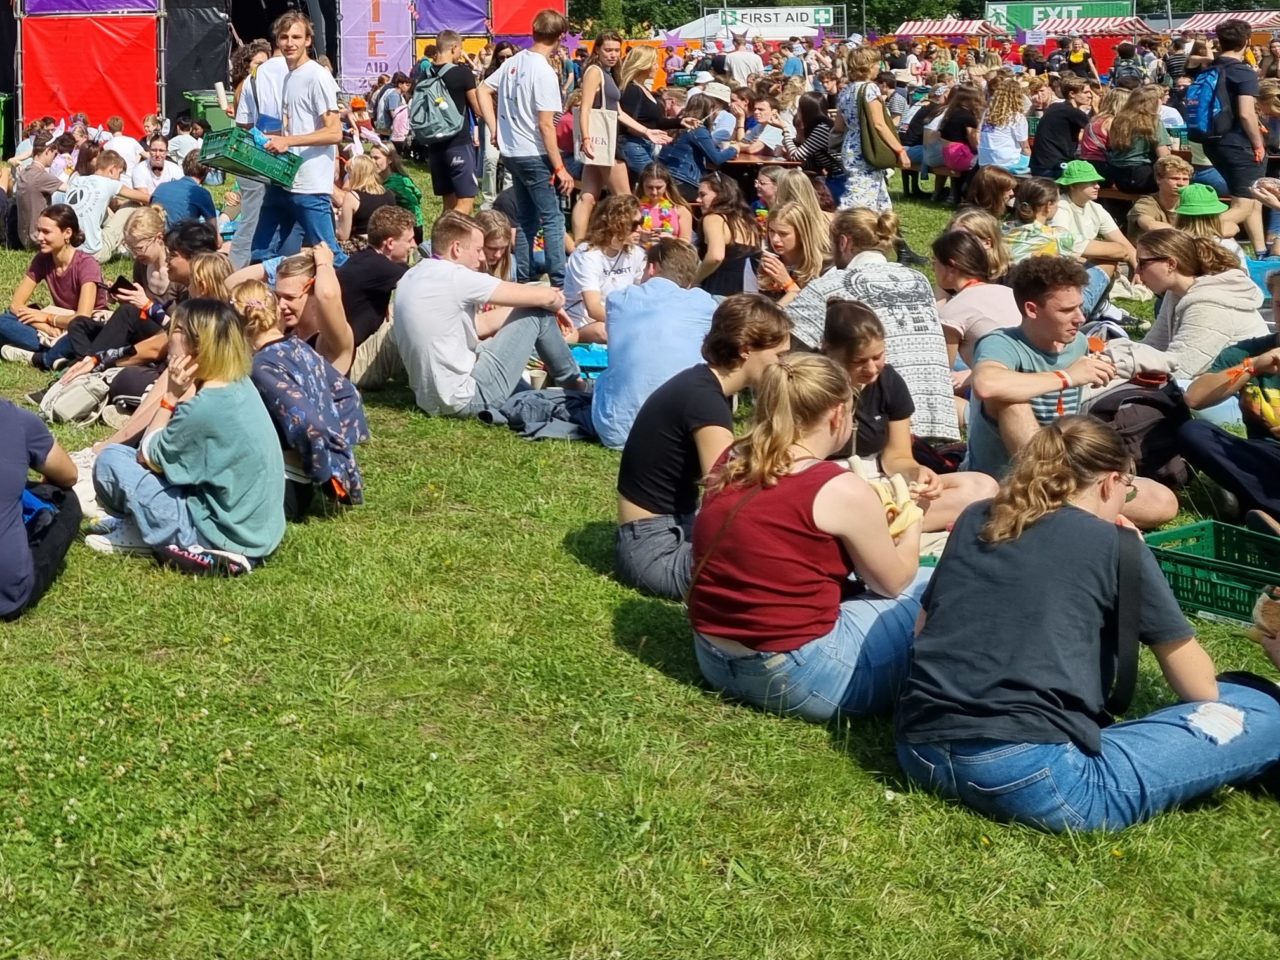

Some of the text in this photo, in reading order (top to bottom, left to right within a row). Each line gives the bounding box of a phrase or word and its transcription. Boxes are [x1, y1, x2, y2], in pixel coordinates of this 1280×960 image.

[741, 12, 809, 24] FIRST AID
[1033, 6, 1083, 25] EXIT
[365, 62, 389, 73] AID
